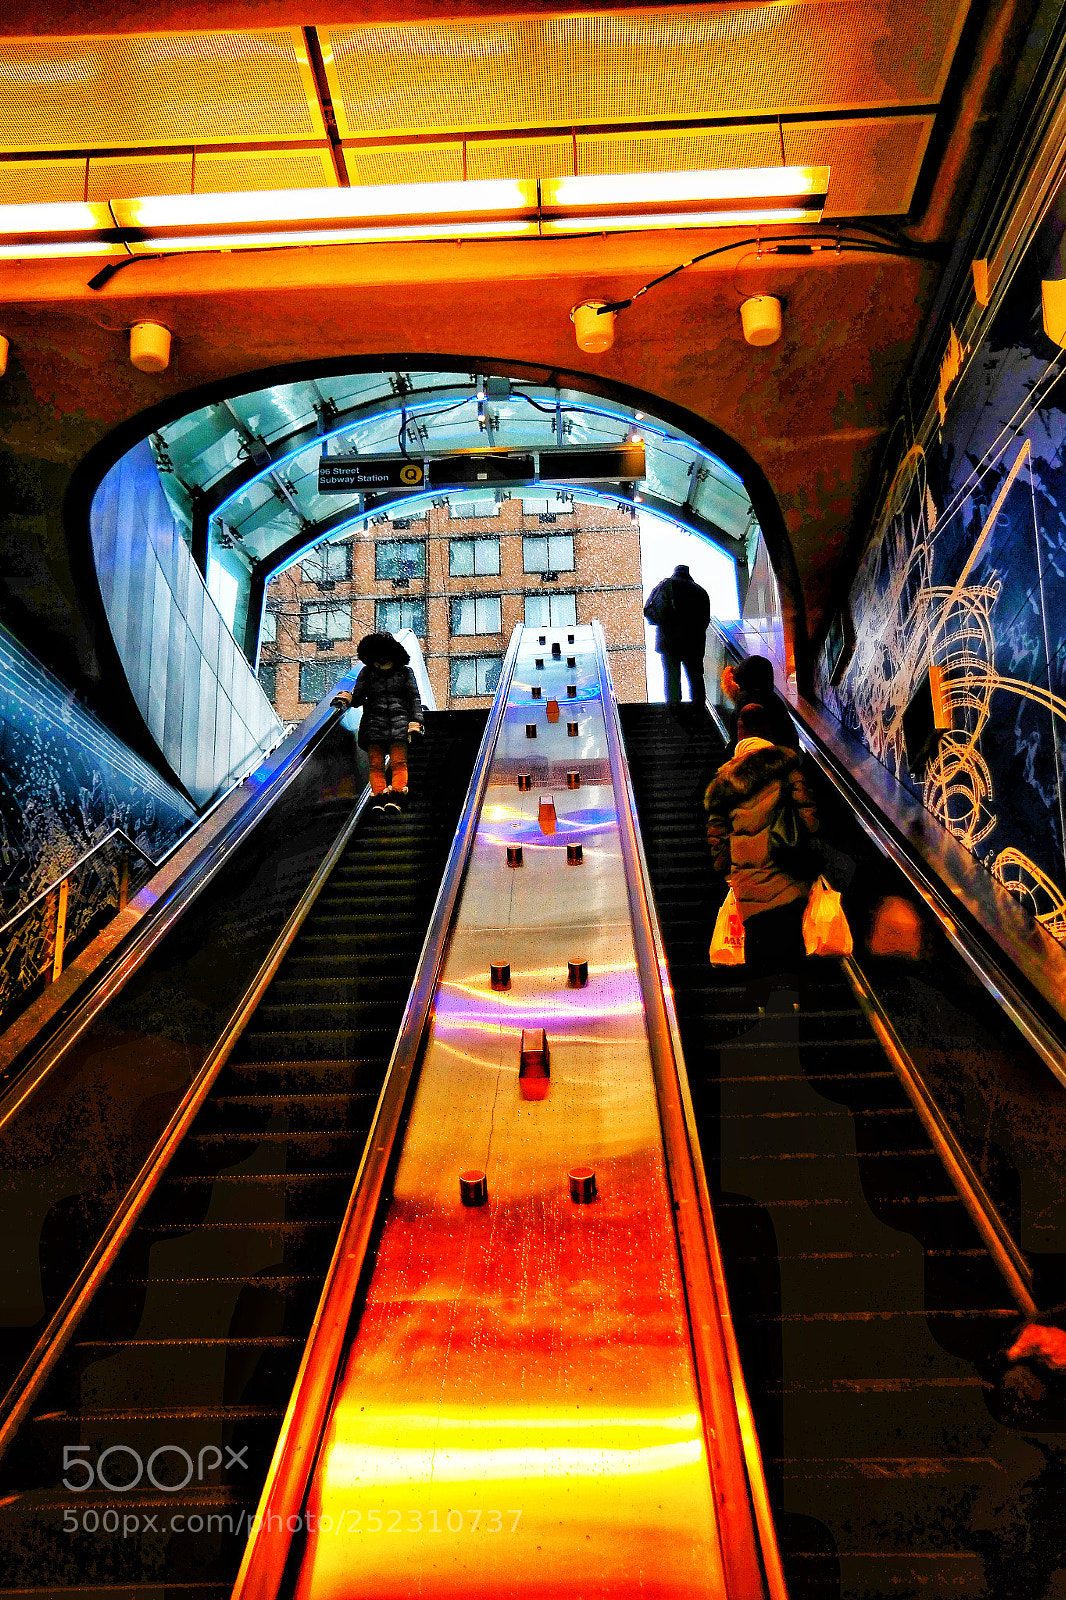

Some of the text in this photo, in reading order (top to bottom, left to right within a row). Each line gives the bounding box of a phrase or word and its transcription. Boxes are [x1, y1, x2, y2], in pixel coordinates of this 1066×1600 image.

[332, 467, 360, 475] Street
[404, 468, 417, 480] Q
[319, 474, 389, 484] Subway Station
